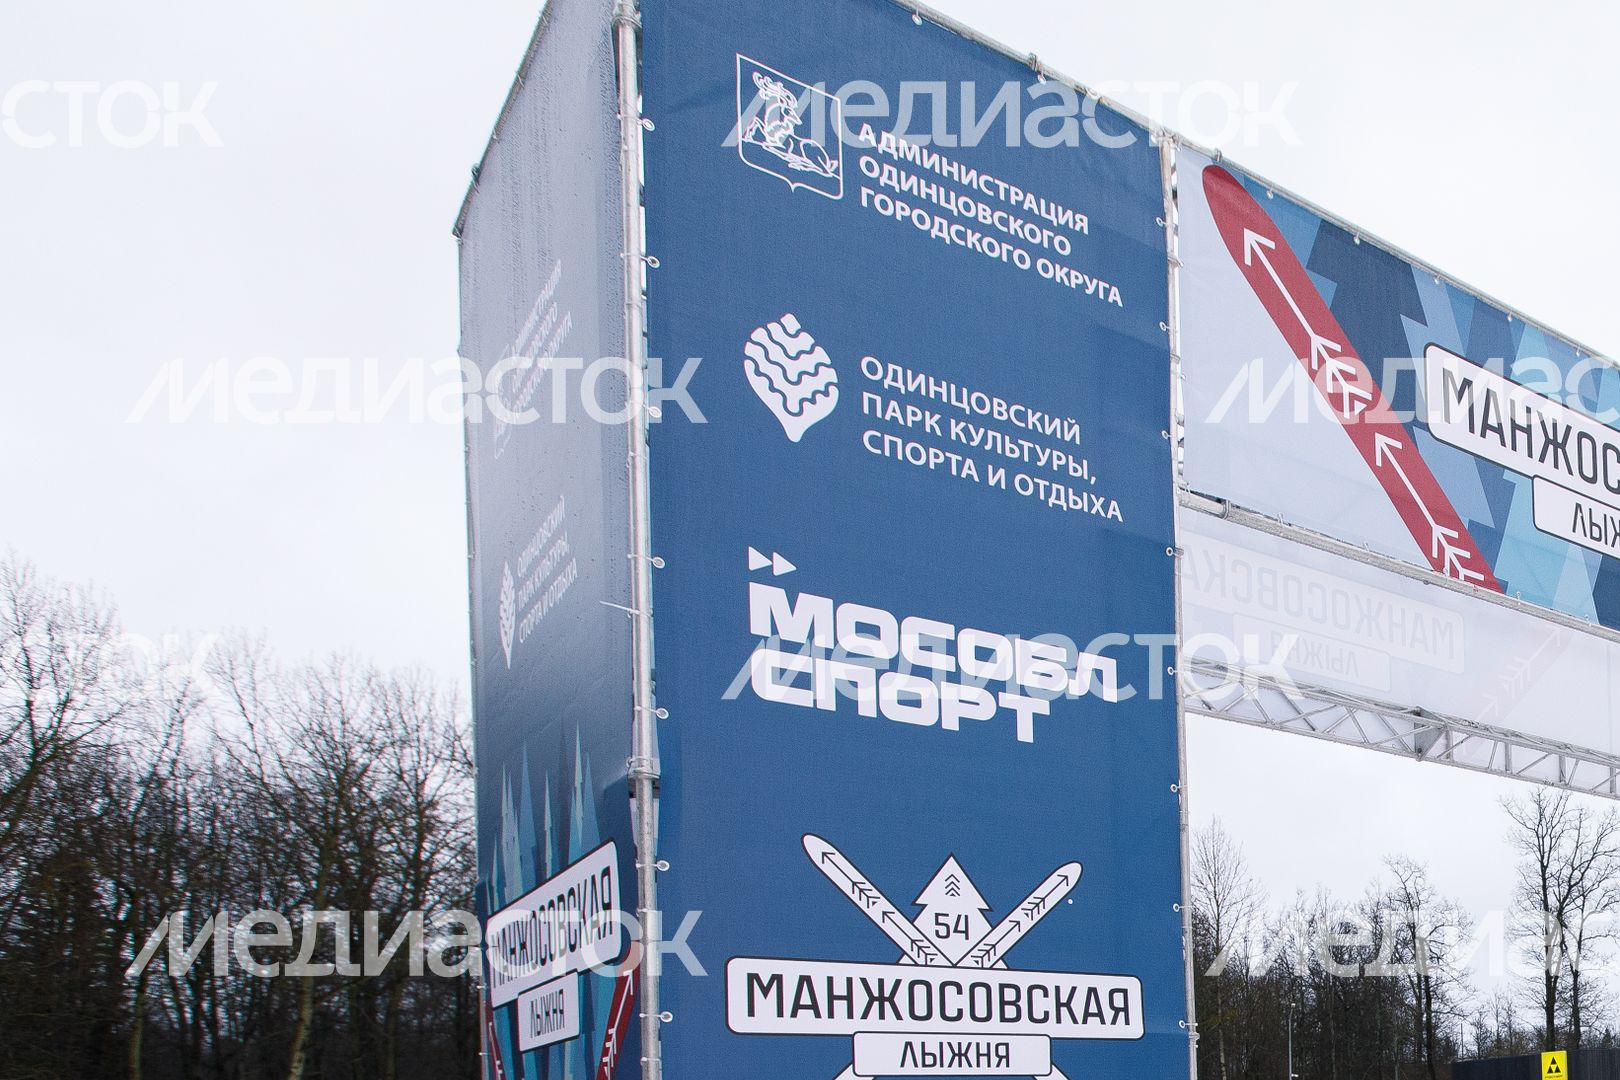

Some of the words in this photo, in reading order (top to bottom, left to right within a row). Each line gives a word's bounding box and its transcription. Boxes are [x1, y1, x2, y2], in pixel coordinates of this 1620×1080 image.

[858, 122, 1089, 236] АДМИНИСТРАЦИЯ
[859, 154, 1072, 257] ОДИНЦОВСКОГО
[860, 185, 1032, 273] ГОРОДСКОГО
[1035, 253, 1124, 308] ОКРУГА
[860, 355, 1082, 446] ОДИНЦОВСКИЙ
[862, 391, 941, 438] ПАРК
[948, 415, 1098, 486] КУЛЬТУРЫ,
[862, 428, 978, 485] СПОРТА
[988, 463, 1007, 491] И
[1012, 471, 1124, 524] ОТДЫХА
[748, 580, 1118, 703] МОСОБЛ
[749, 648, 1051, 743] СПОРТ
[490, 866, 613, 988] МАНЖОСОВСКАЯ
[933, 911, 971, 942] 54
[529, 987, 565, 1039] ЛЫЖНЯ
[745, 970, 1132, 1027] МАНЖОСОВСКАЯ
[899, 1040, 1011, 1069] ЛЫЖНЯ
